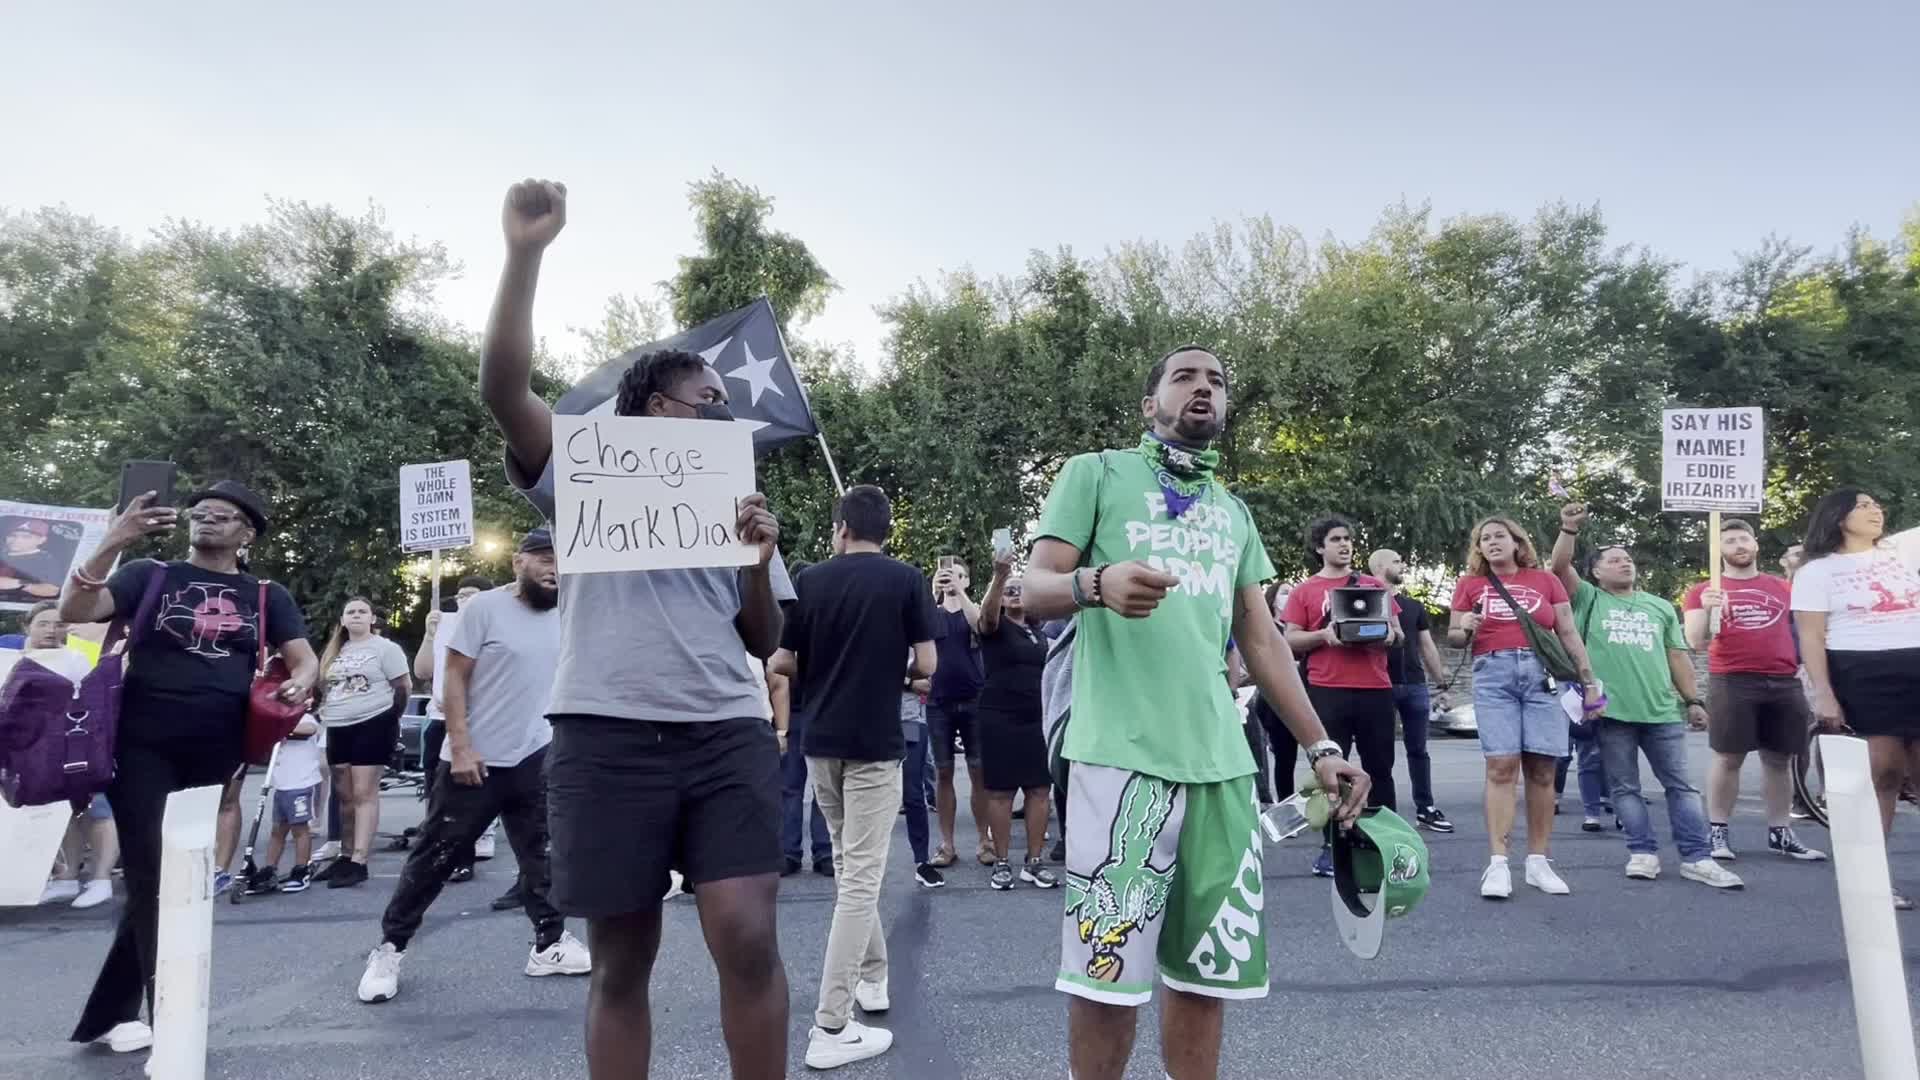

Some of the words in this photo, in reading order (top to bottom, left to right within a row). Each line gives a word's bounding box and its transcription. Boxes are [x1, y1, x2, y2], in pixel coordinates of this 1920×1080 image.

[1672, 414, 1710, 431] SAY
[1718, 413, 1752, 431] HIS
[567, 422, 704, 488] Charge
[1676, 439, 1746, 457] NAME!
[424, 466, 446, 480] THE
[1686, 463, 1737, 479] EDDIE
[414, 477, 456, 493] WHOLE
[1667, 482, 1755, 499] IRIZARRY!
[417, 490, 454, 505] DAMN
[411, 508, 460, 525] SYSTEM
[1144, 492, 1232, 536] POR
[405, 529, 417, 541] IS
[422, 522, 467, 539] GUILTY!
[567, 499, 664, 557] Mark
